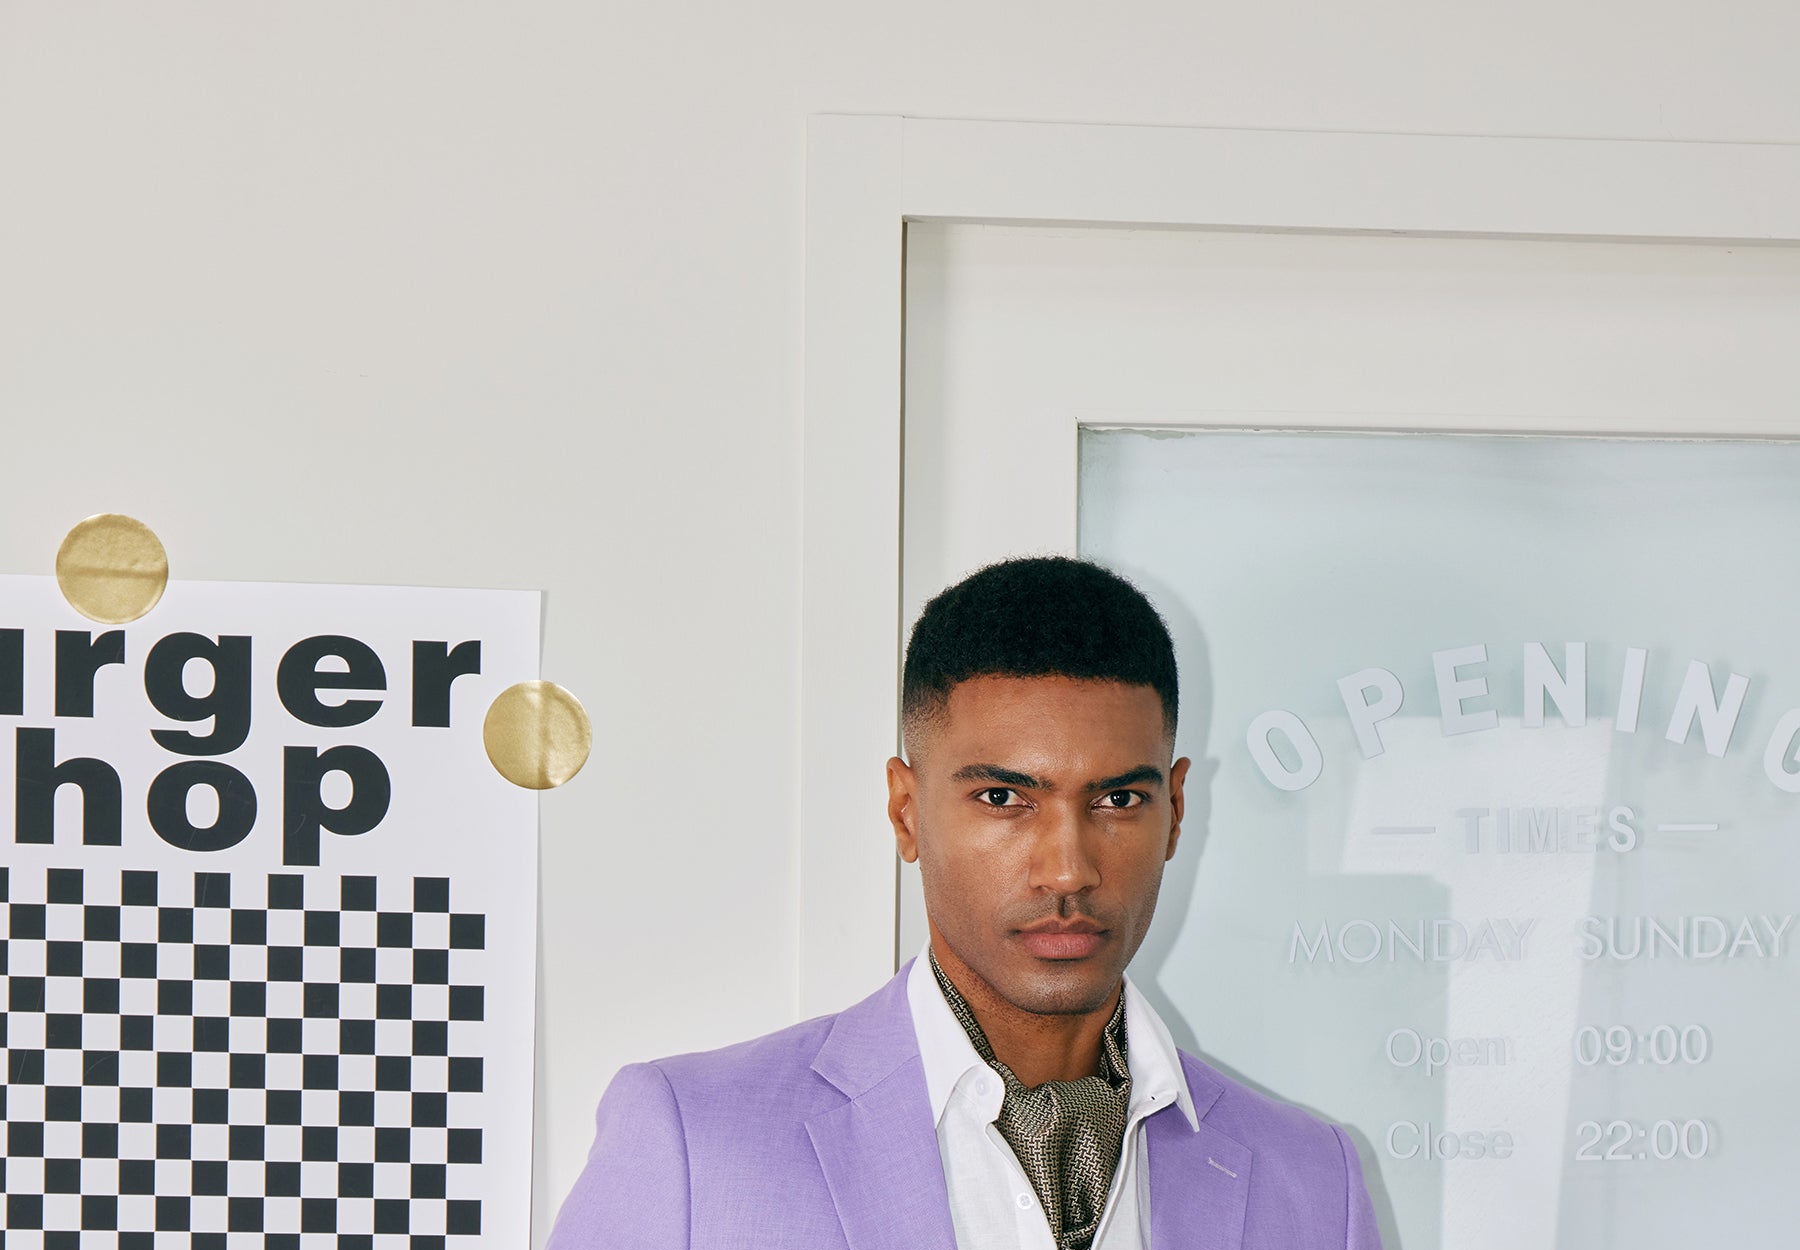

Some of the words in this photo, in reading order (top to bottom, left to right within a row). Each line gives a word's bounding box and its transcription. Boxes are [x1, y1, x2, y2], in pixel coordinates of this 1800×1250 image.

[0, 628, 481, 756] rger
[15, 727, 391, 867] hop
[1456, 806, 1642, 854] TIMES
[1288, 918, 1536, 965] MONDAY
[1576, 914, 1794, 962] SUNDAY
[1385, 1026, 1511, 1076] Open
[1576, 1024, 1711, 1067] 09:00
[1385, 1120, 1515, 1161] Close
[1575, 1119, 1712, 1162] 22:00
